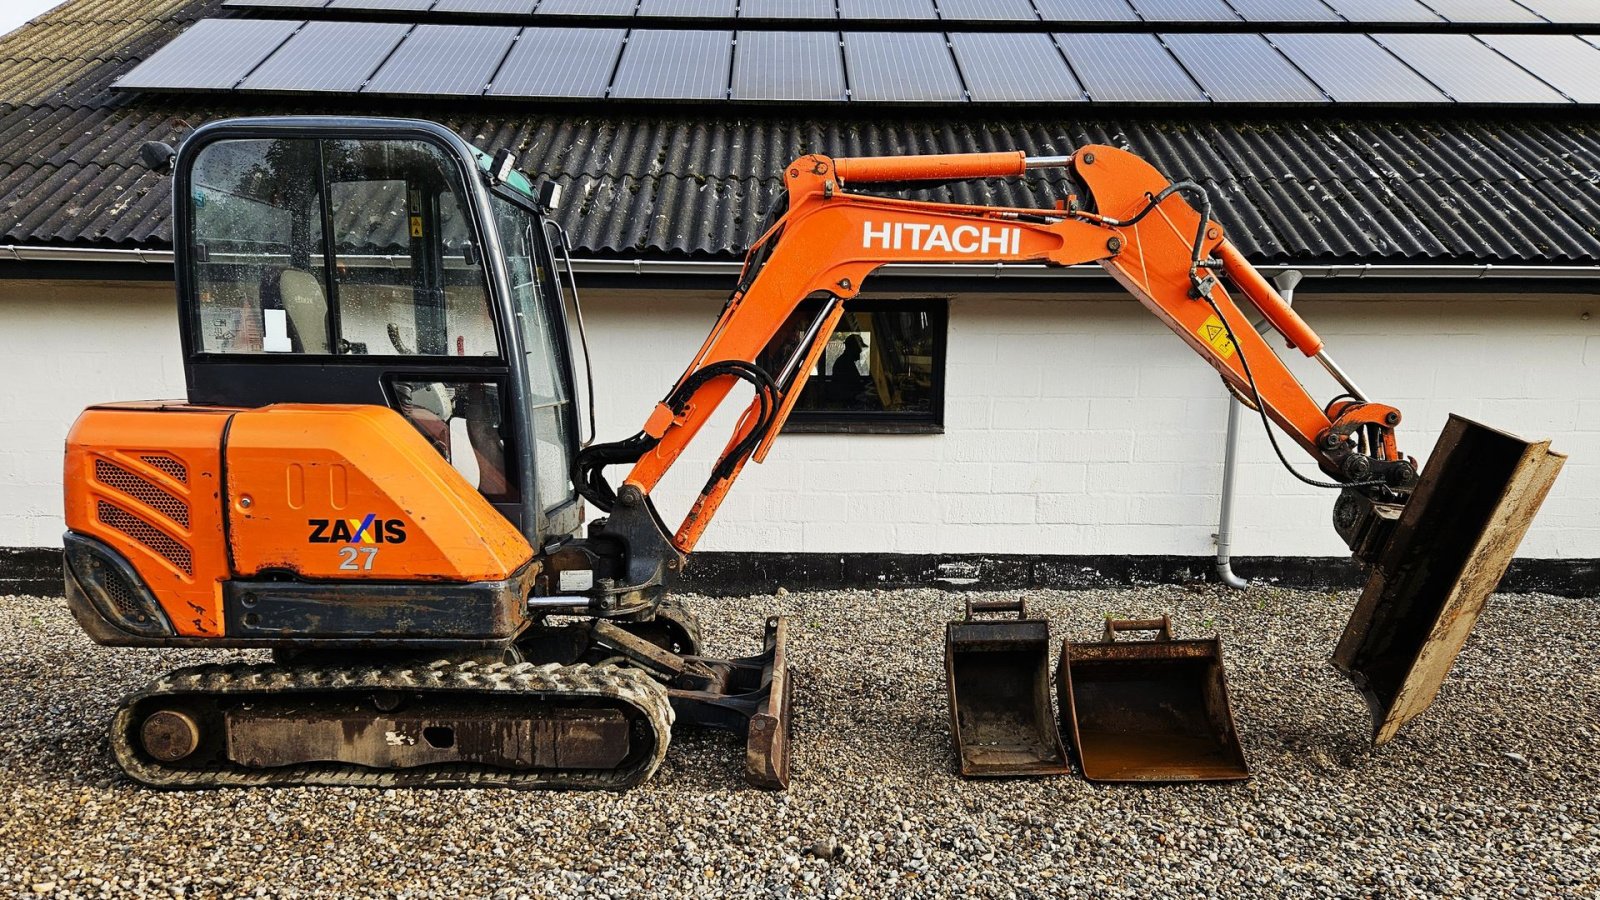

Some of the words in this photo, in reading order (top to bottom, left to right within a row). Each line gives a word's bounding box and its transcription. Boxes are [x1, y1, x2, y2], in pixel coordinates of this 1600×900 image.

[863, 221, 1021, 255] HITACHI
[308, 513, 407, 544] ZAXIS
[339, 546, 379, 570] 27
